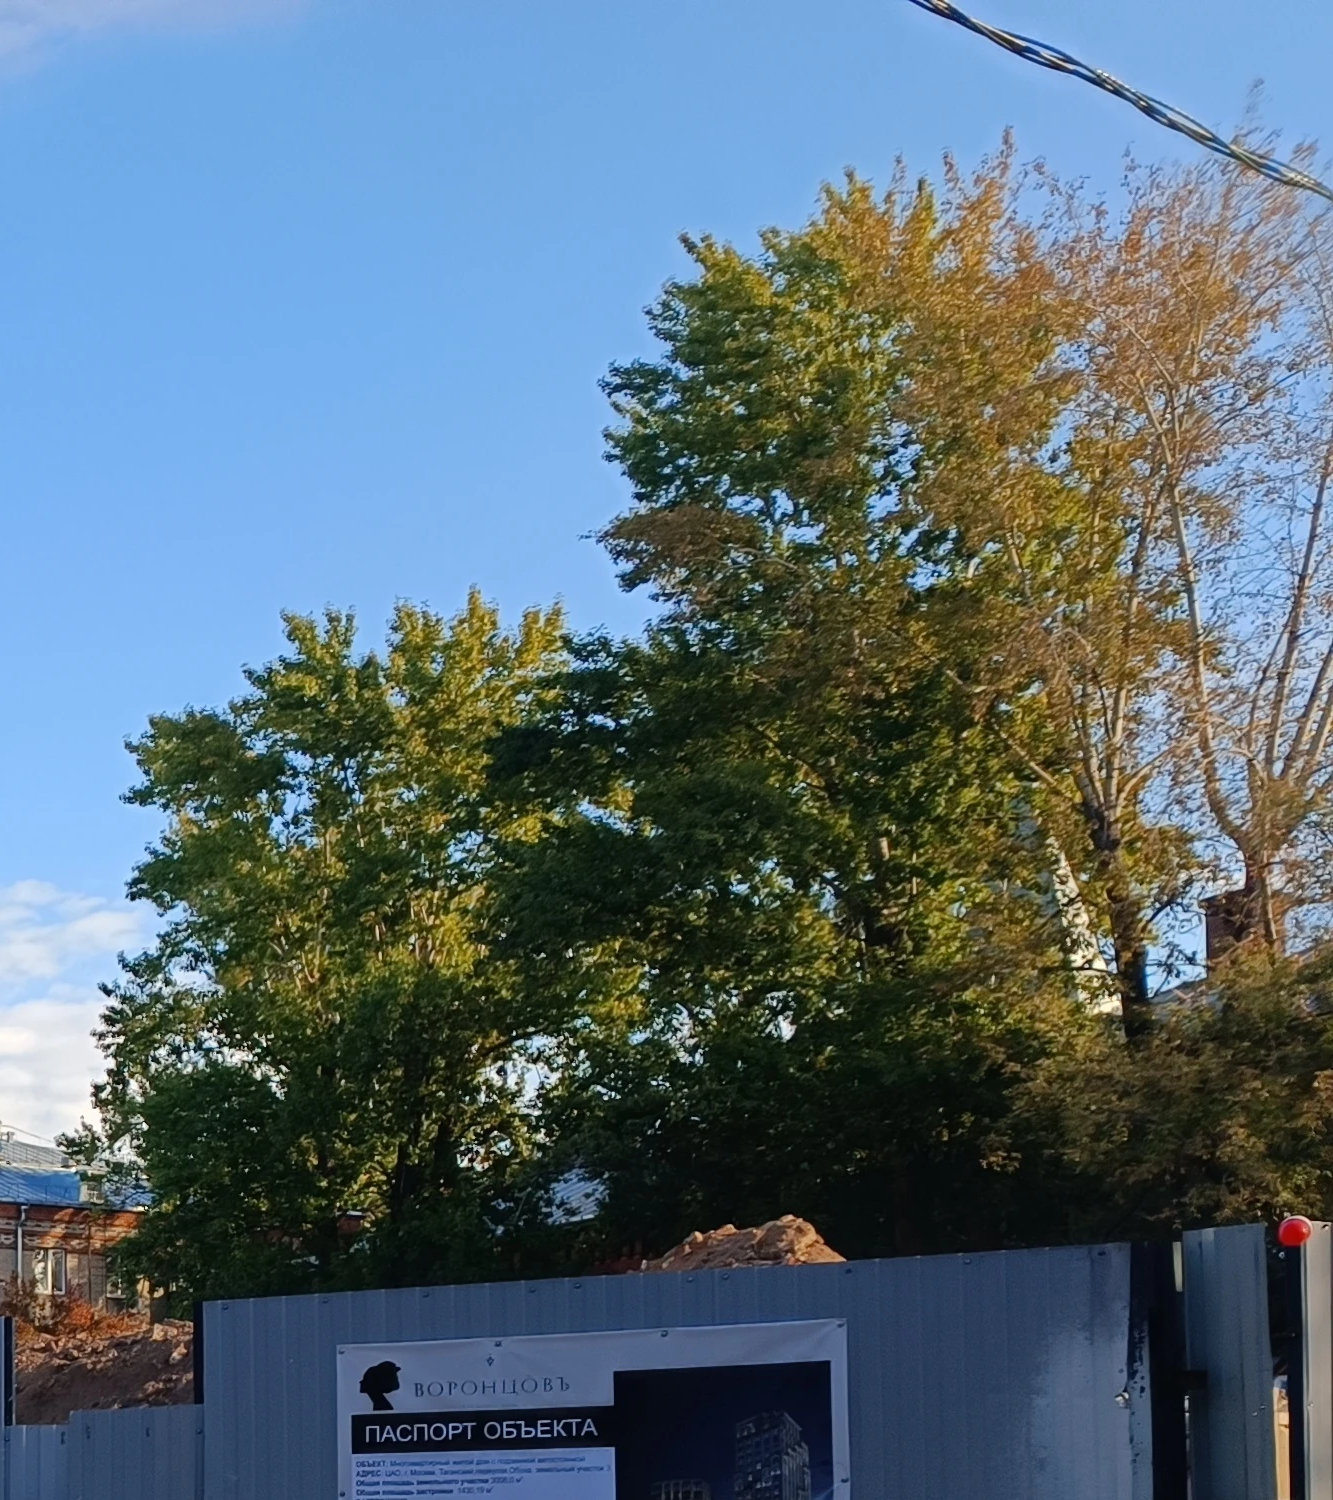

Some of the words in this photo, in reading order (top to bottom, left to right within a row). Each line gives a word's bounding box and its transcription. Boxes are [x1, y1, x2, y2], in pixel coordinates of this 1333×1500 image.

[414, 1375, 570, 1398] ВОРОНЦОВЪ
[365, 1422, 477, 1444] ПАСПОРТ
[484, 1418, 599, 1440] ОБЪЕКТА
